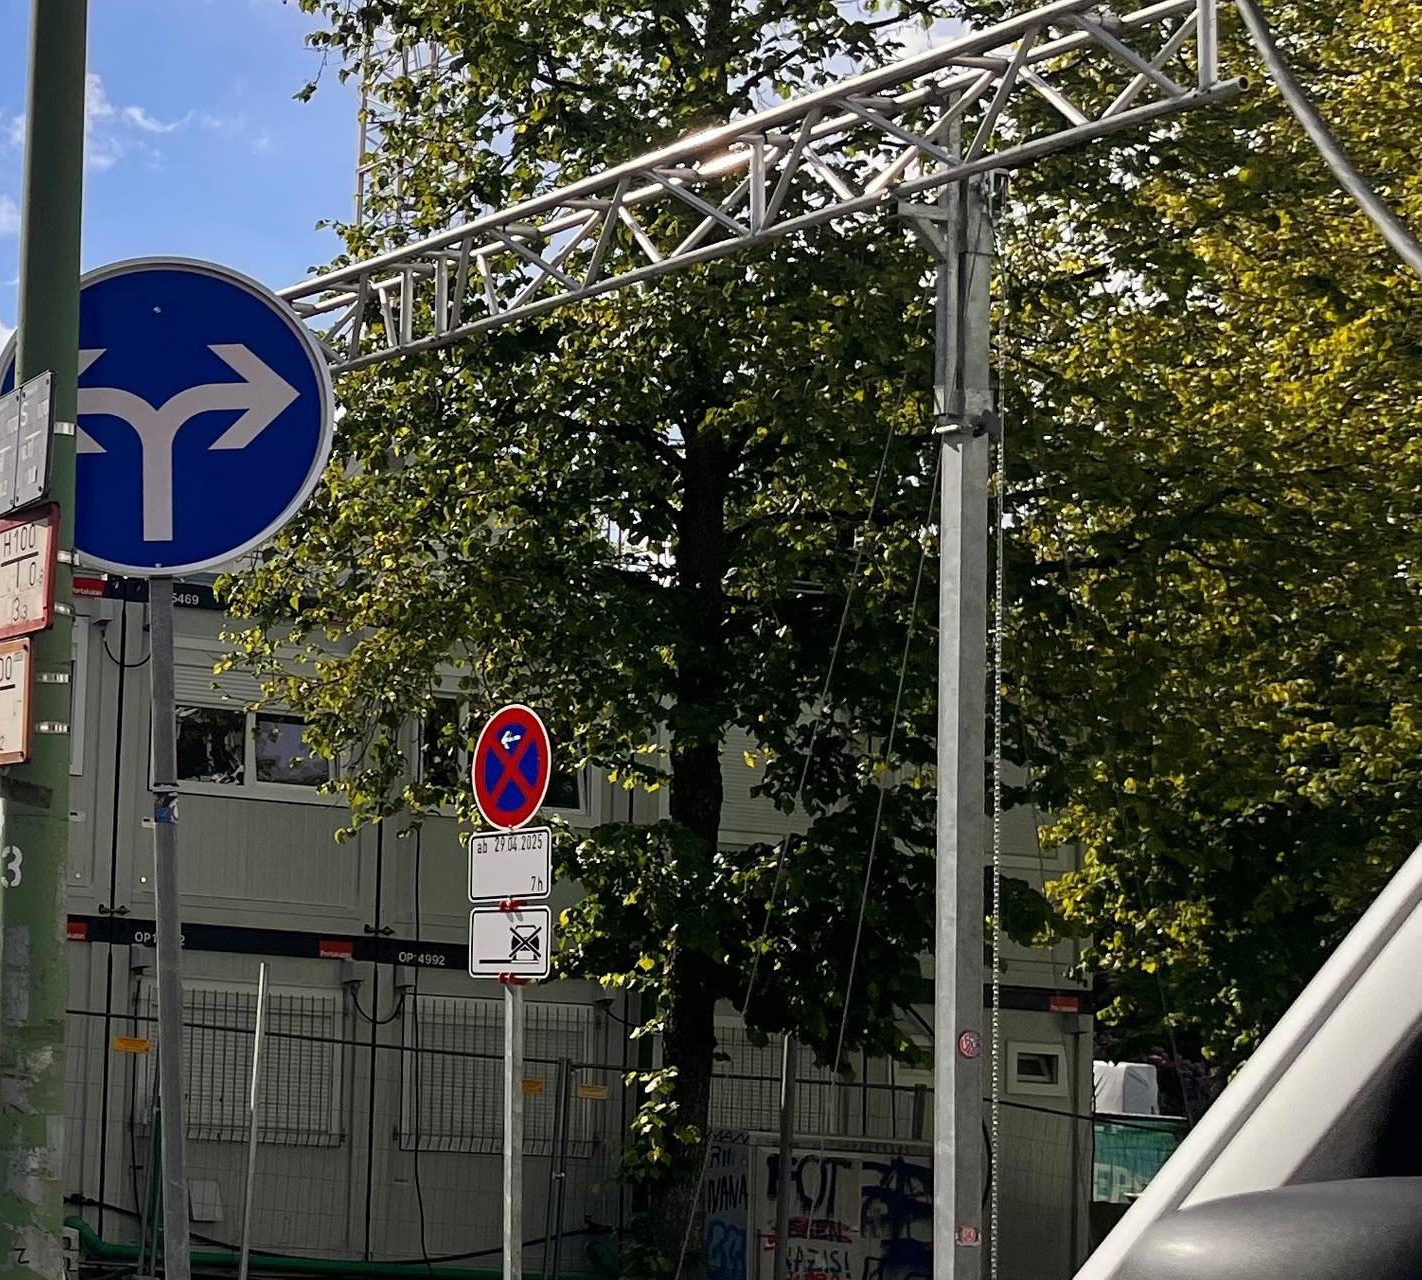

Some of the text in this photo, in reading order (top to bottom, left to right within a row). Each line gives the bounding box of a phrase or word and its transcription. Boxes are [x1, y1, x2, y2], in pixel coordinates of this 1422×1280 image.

[172, 592, 200, 606] 5469
[477, 839, 488, 854] ab
[1, 845, 23, 889] 3
